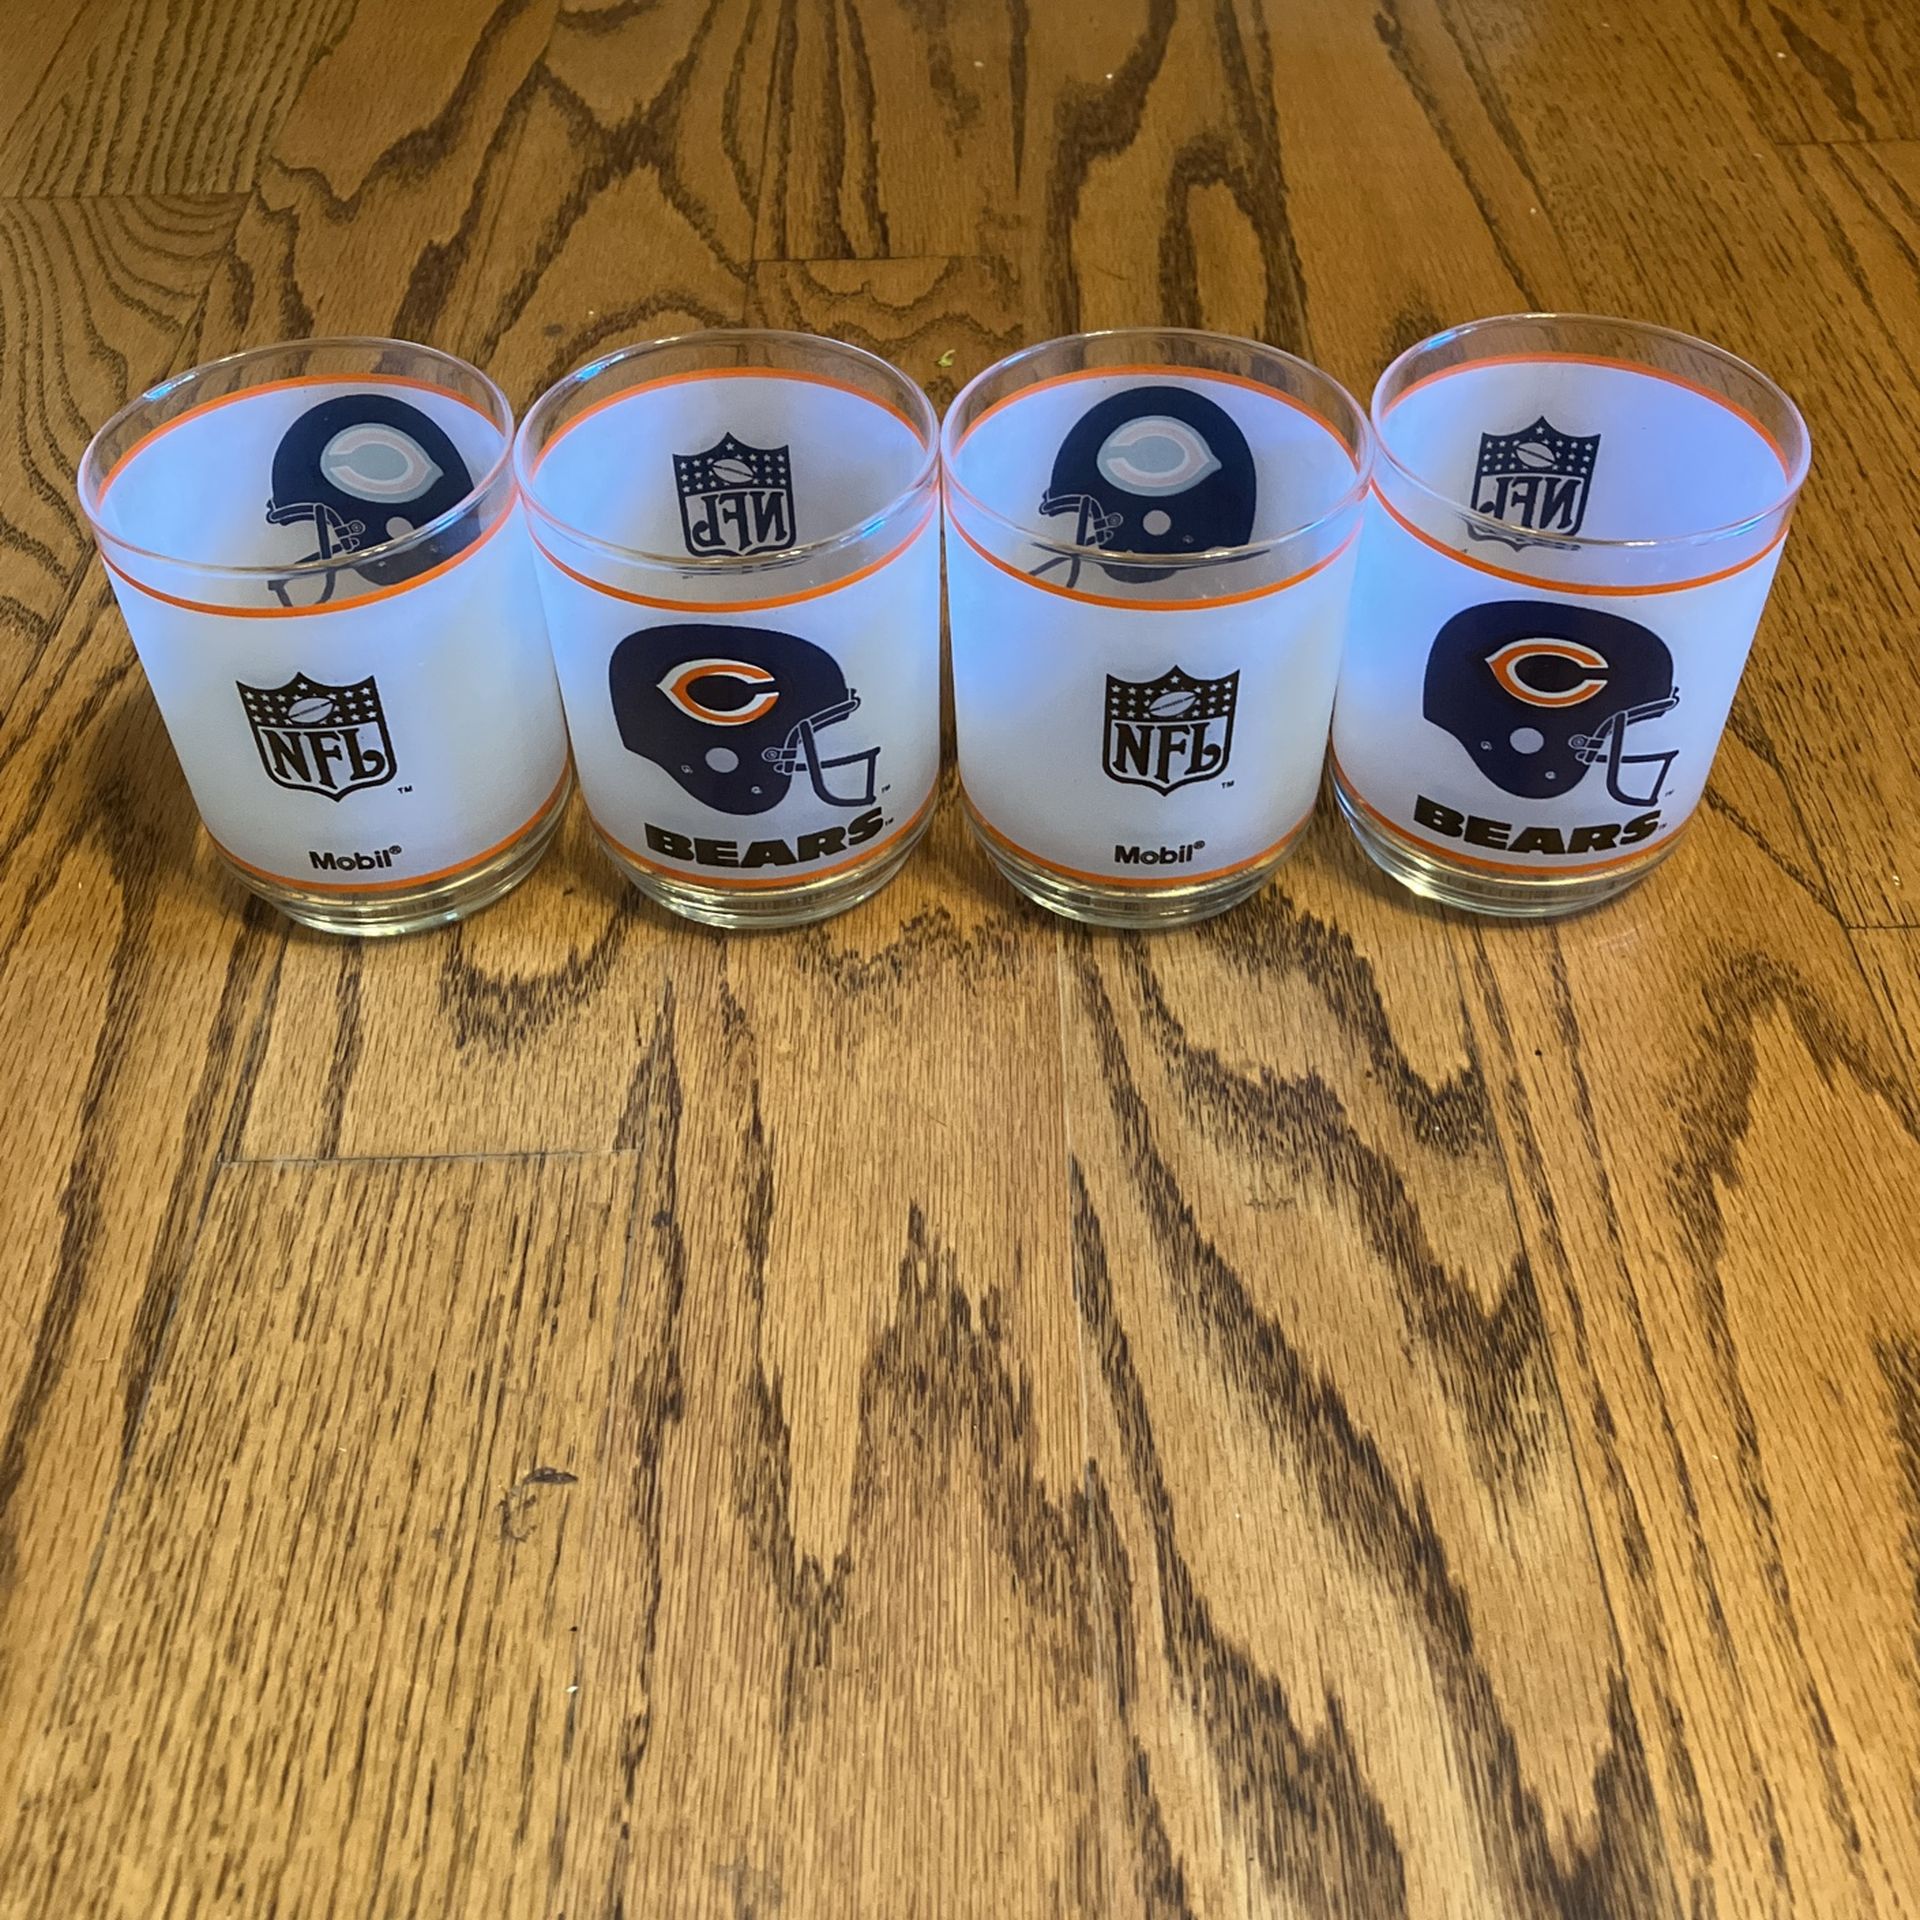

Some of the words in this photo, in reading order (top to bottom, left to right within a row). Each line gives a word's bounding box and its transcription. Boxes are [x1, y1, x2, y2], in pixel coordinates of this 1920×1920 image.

[260, 727, 386, 790] NFL
[1112, 722, 1222, 784] NFL
[644, 807, 884, 868] BEARS
[1413, 794, 1661, 854] BEARS
